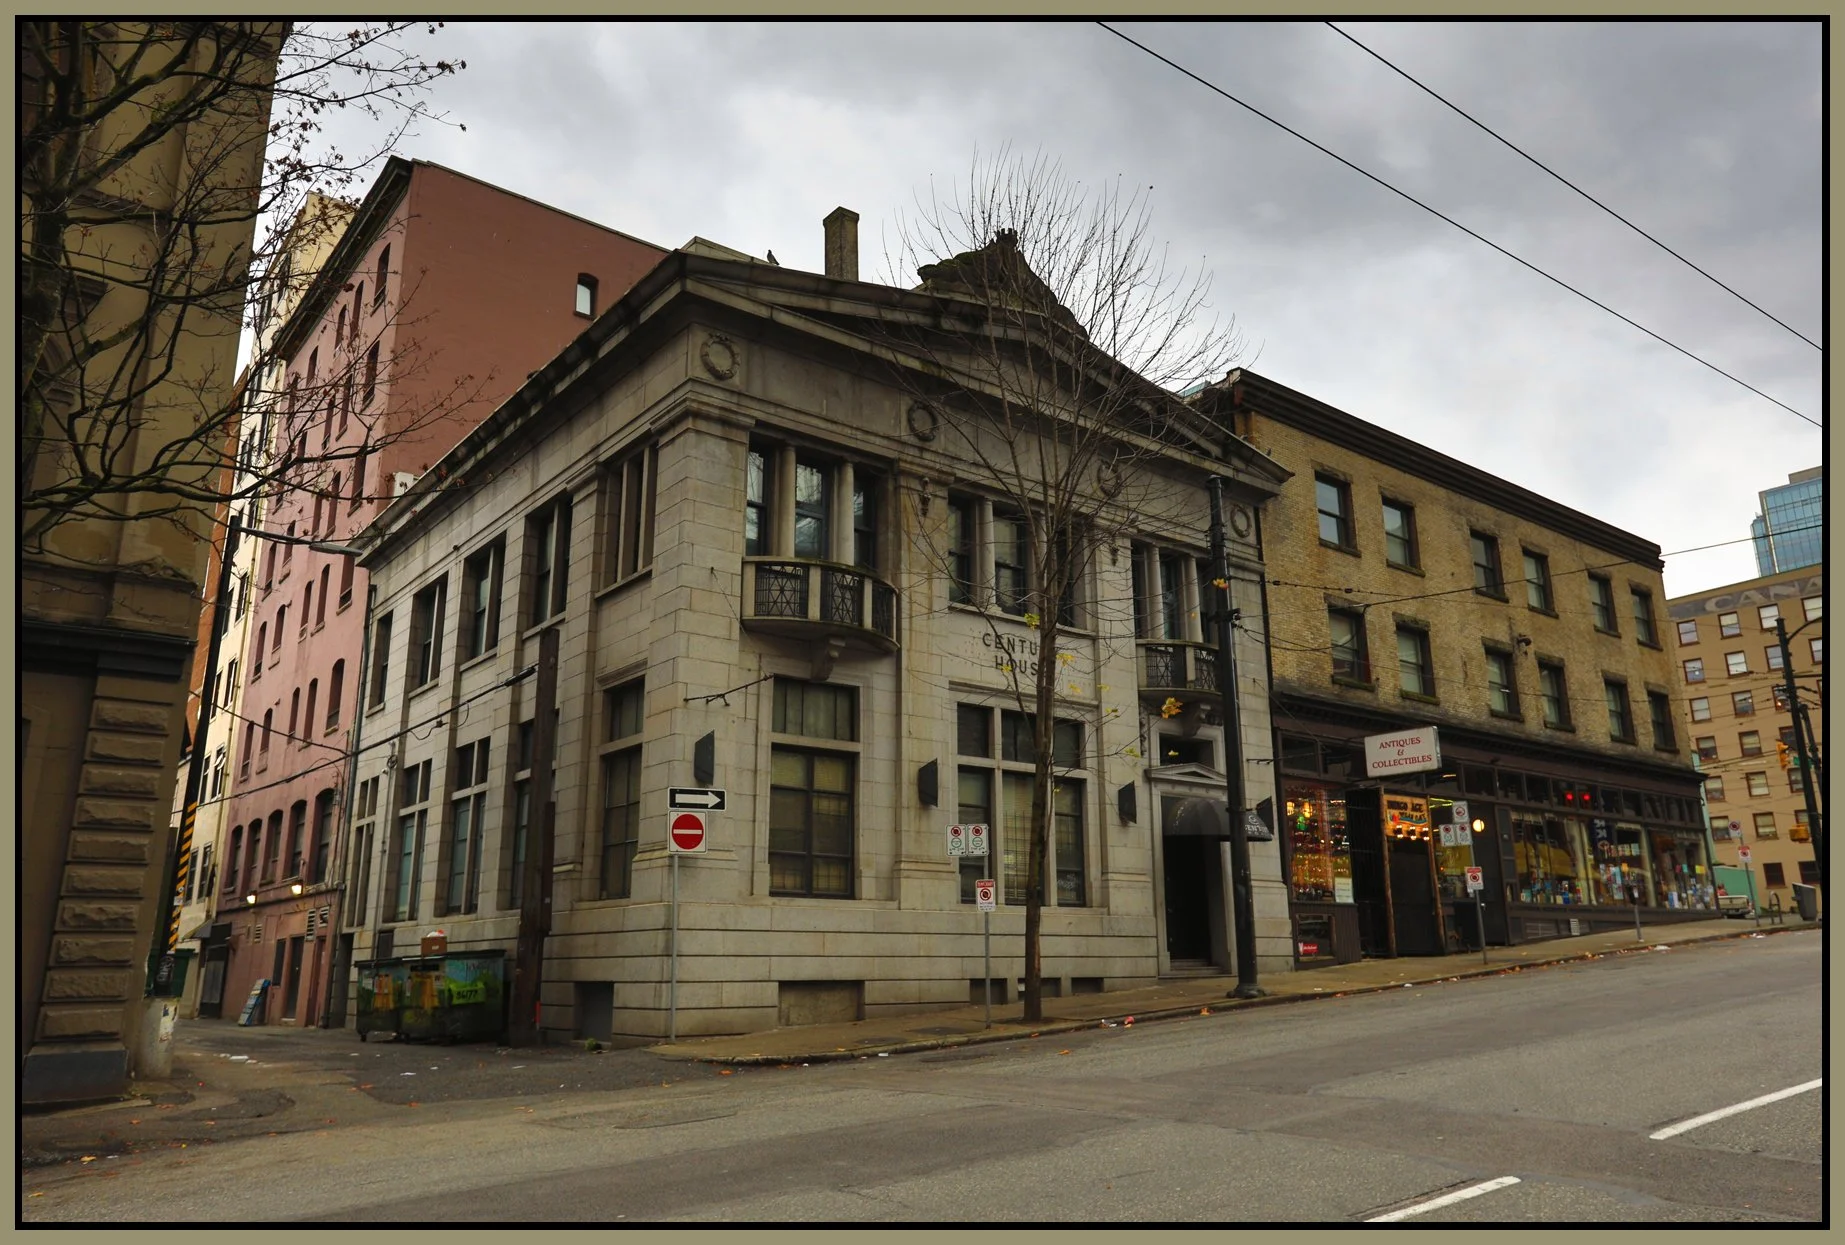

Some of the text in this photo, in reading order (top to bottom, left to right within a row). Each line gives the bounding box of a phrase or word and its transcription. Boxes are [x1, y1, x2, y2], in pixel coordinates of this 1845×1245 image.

[983, 632, 1039, 656] CENTU
[995, 655, 1040, 676] HOUS
[1379, 736, 1421, 749] ANTIQUES
[1372, 754, 1432, 769] COLLECTIBLES
